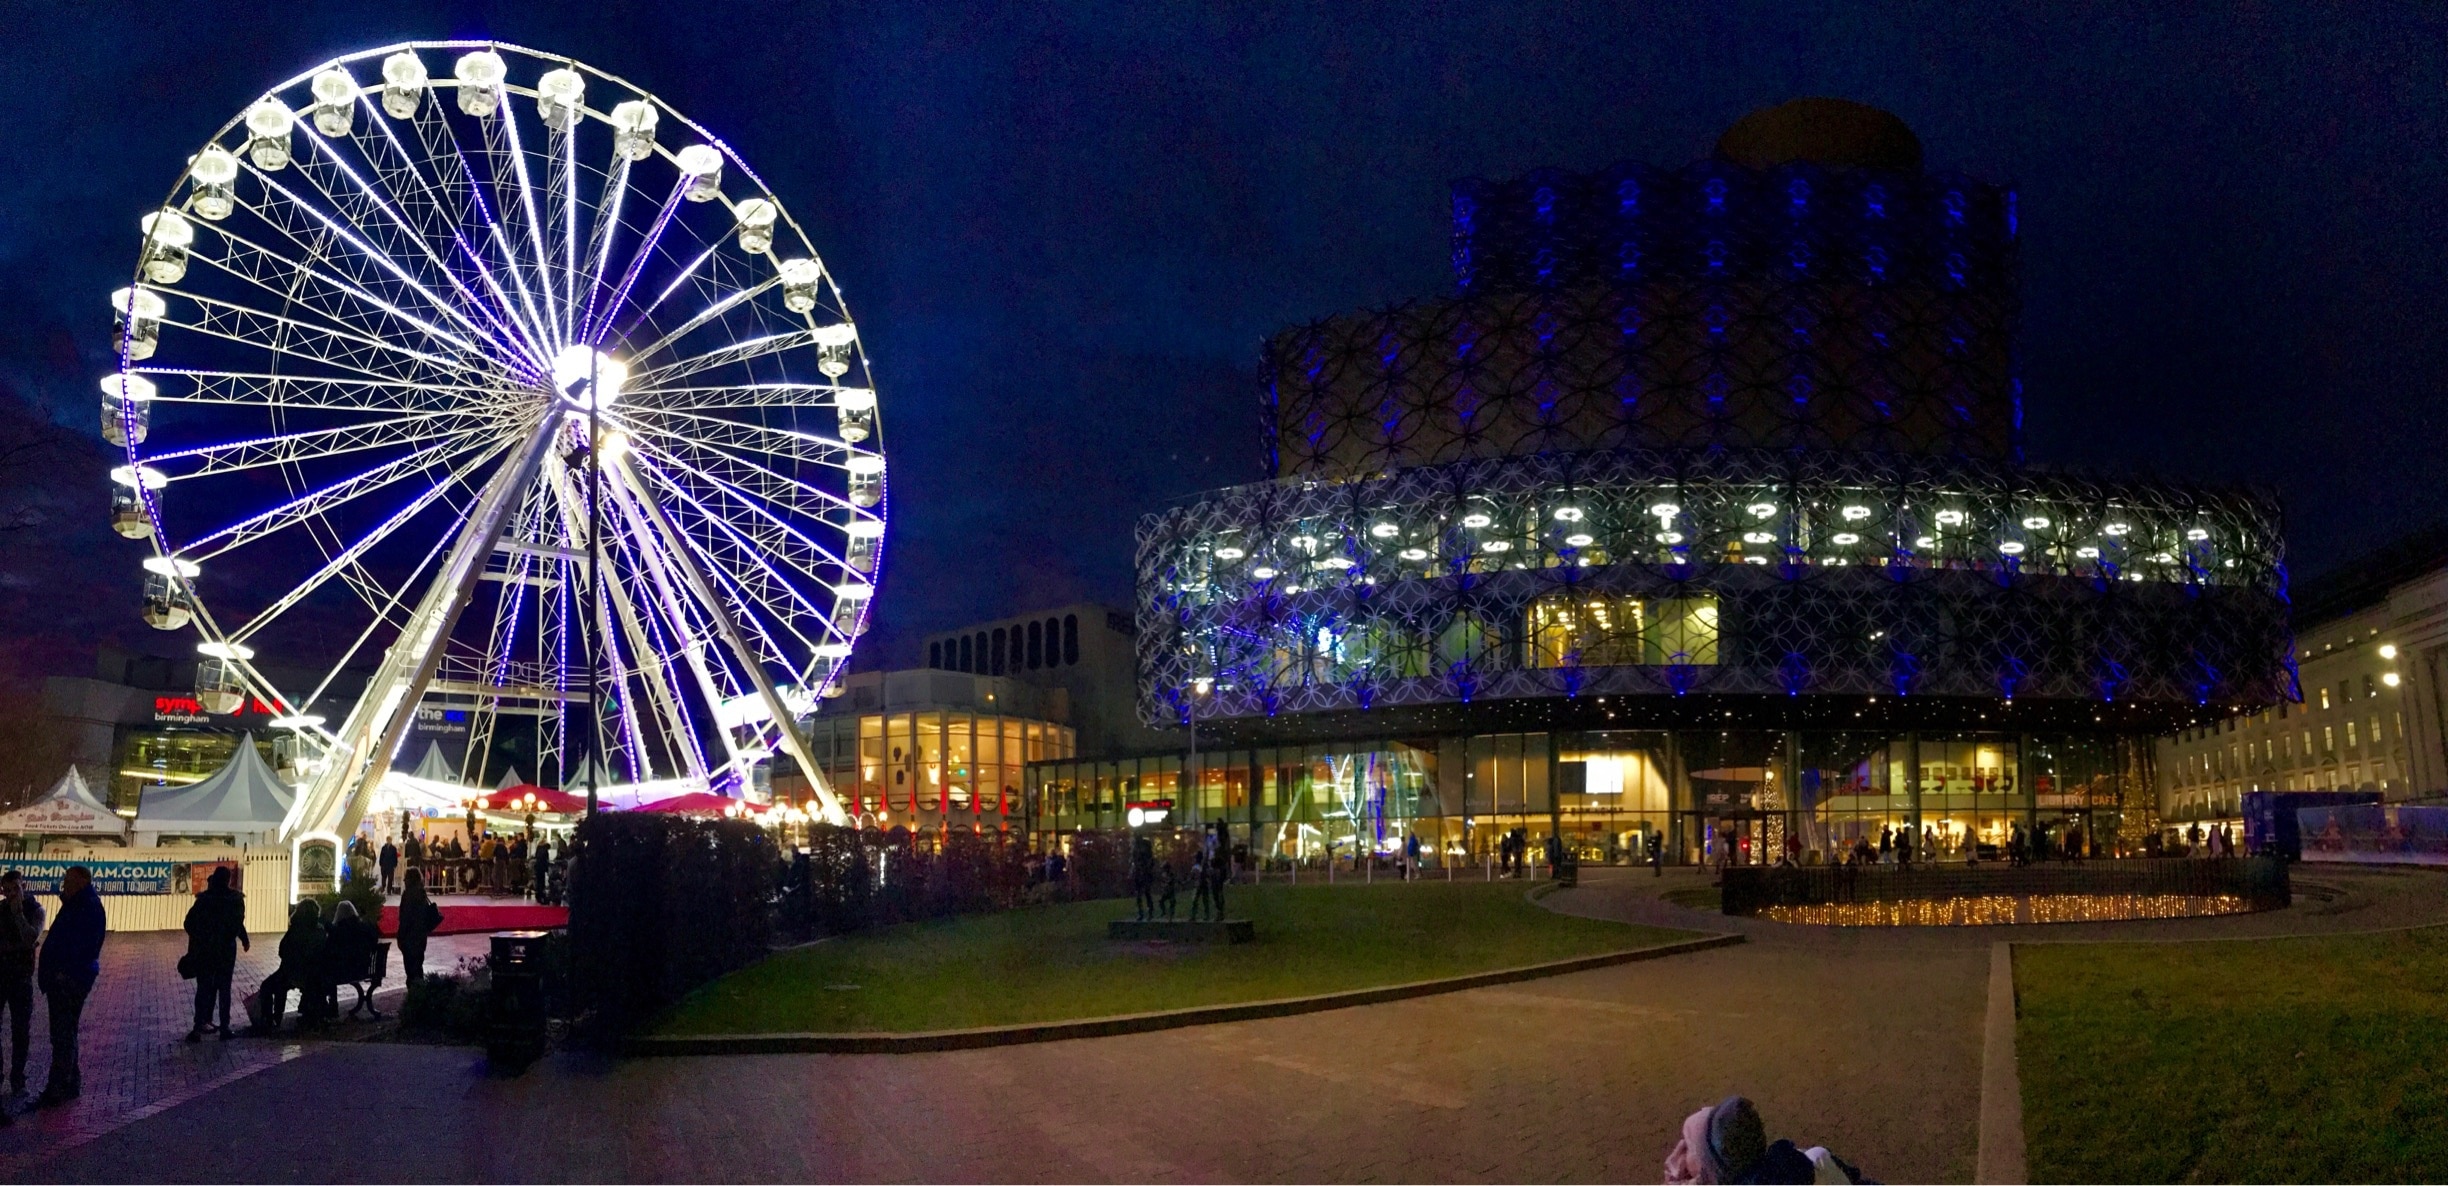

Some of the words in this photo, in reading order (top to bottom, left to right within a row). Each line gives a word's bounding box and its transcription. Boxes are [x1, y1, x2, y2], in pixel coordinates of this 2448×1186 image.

[154, 712, 210, 724] birmingham
[419, 707, 443, 721] the
[417, 723, 466, 733] birmingham
[104, 881, 125, 892] 10AM
[126, 881, 135, 892] TO
[137, 881, 157, 892] 10PM
